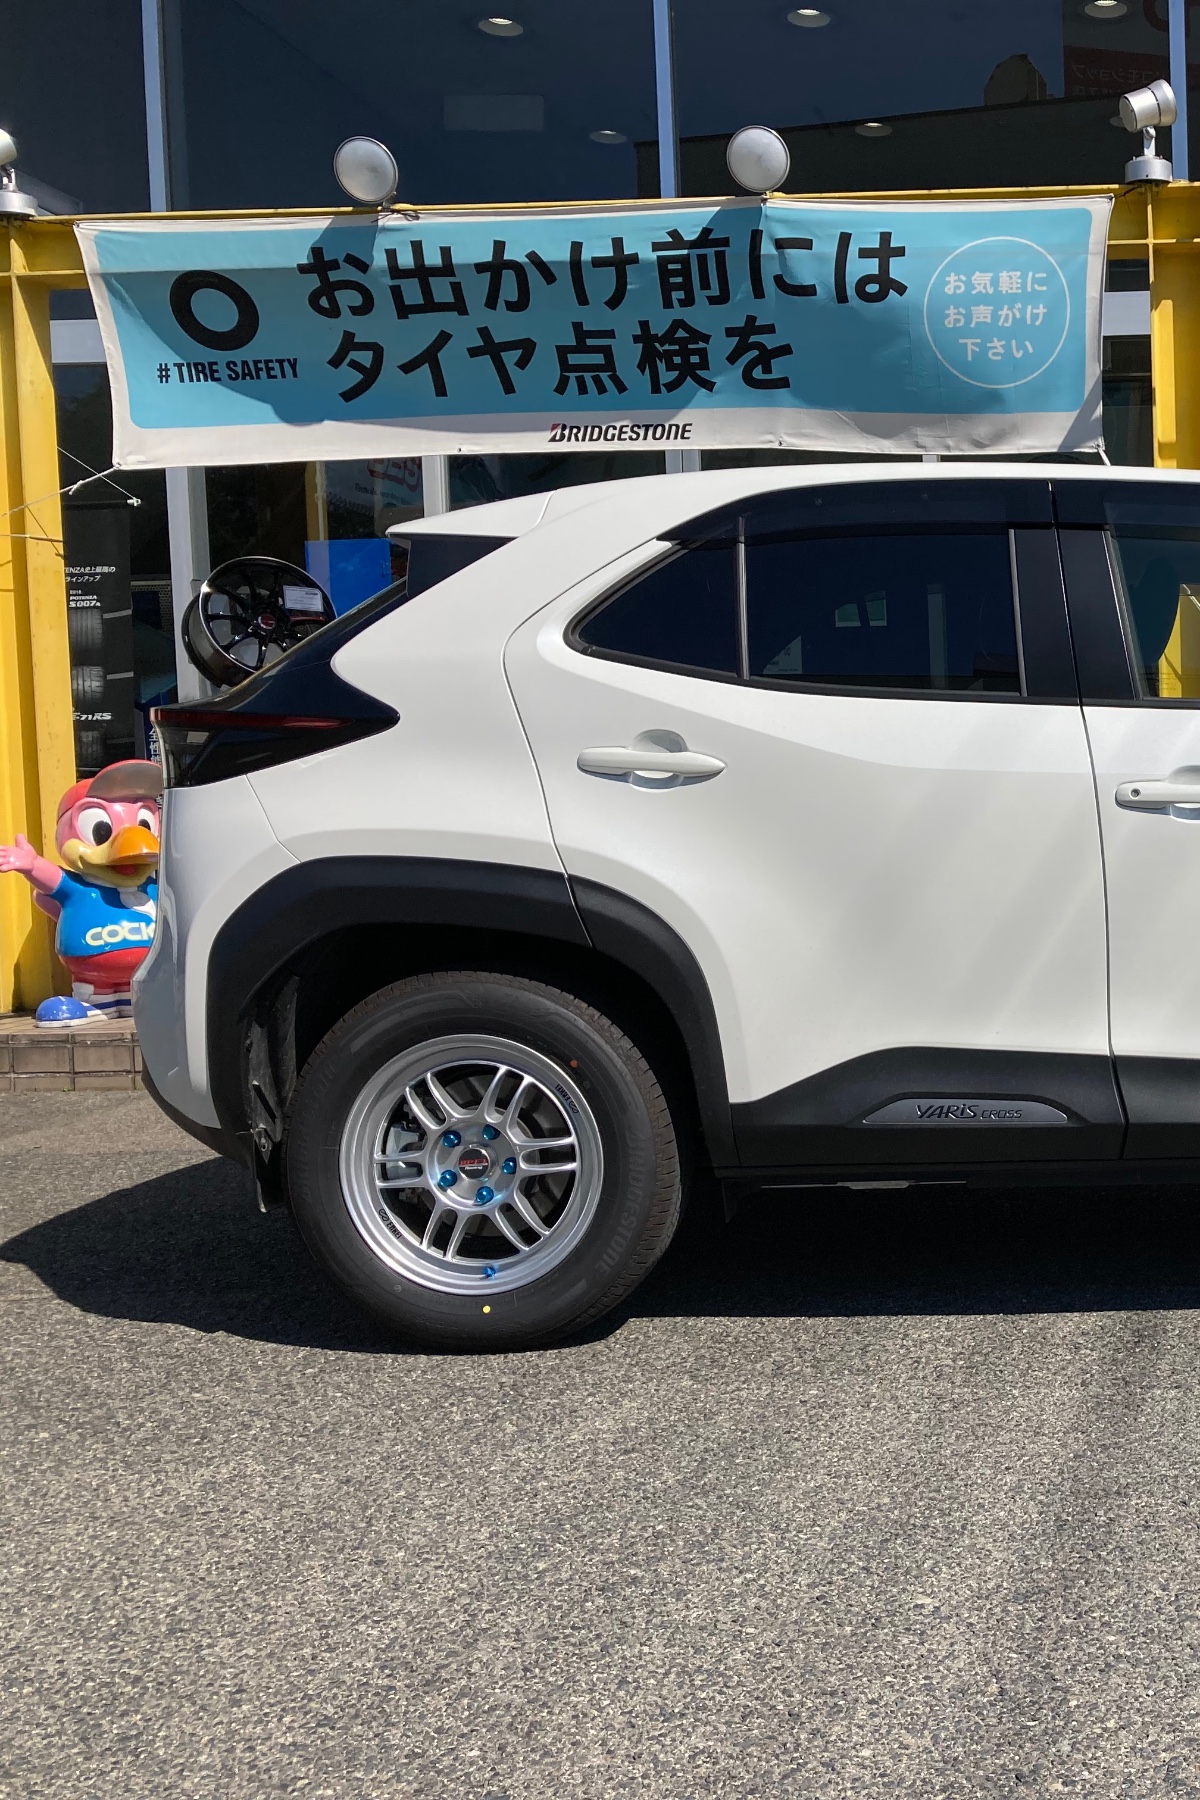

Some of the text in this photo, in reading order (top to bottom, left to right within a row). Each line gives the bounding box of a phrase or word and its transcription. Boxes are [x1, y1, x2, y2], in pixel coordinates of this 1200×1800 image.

[297, 228, 910, 321] お出かけ前には
[943, 269, 1049, 297] お気軽に
[943, 304, 1048, 329] お声がけ
[325, 314, 794, 403] タイヤ点検を
[958, 337, 1035, 362] 下さい
[226, 357, 299, 382] SAFETY
[547, 422, 693, 444] BRIDGESTONE
[980, 1109, 1023, 1120] CROSS
